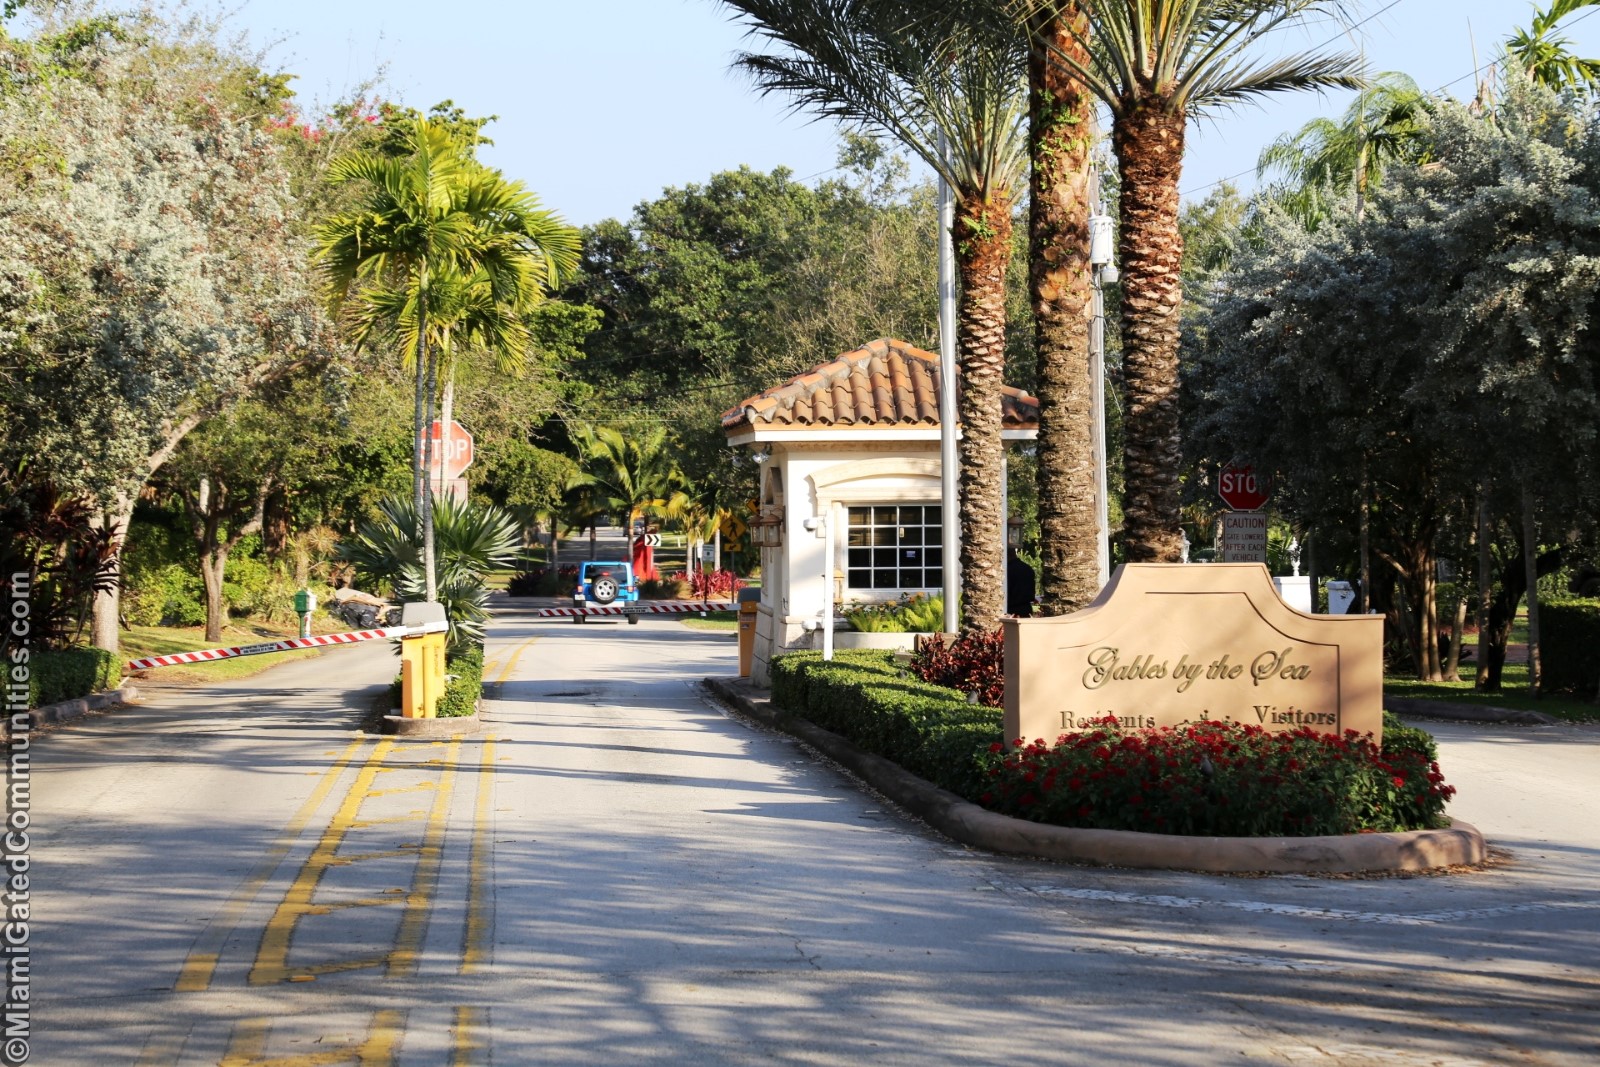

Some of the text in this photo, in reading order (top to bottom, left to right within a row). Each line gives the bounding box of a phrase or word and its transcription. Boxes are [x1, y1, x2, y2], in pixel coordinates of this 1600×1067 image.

[1222, 473, 1257, 494] STO
[1226, 518, 1265, 529] CAUTION
[1225, 543, 1265, 551] AFTER EACH
[1231, 553, 1259, 561] VEHICLE
[1082, 646, 1312, 694] Gables by the Sea
[1060, 705, 1337, 729] Resents Visitors
